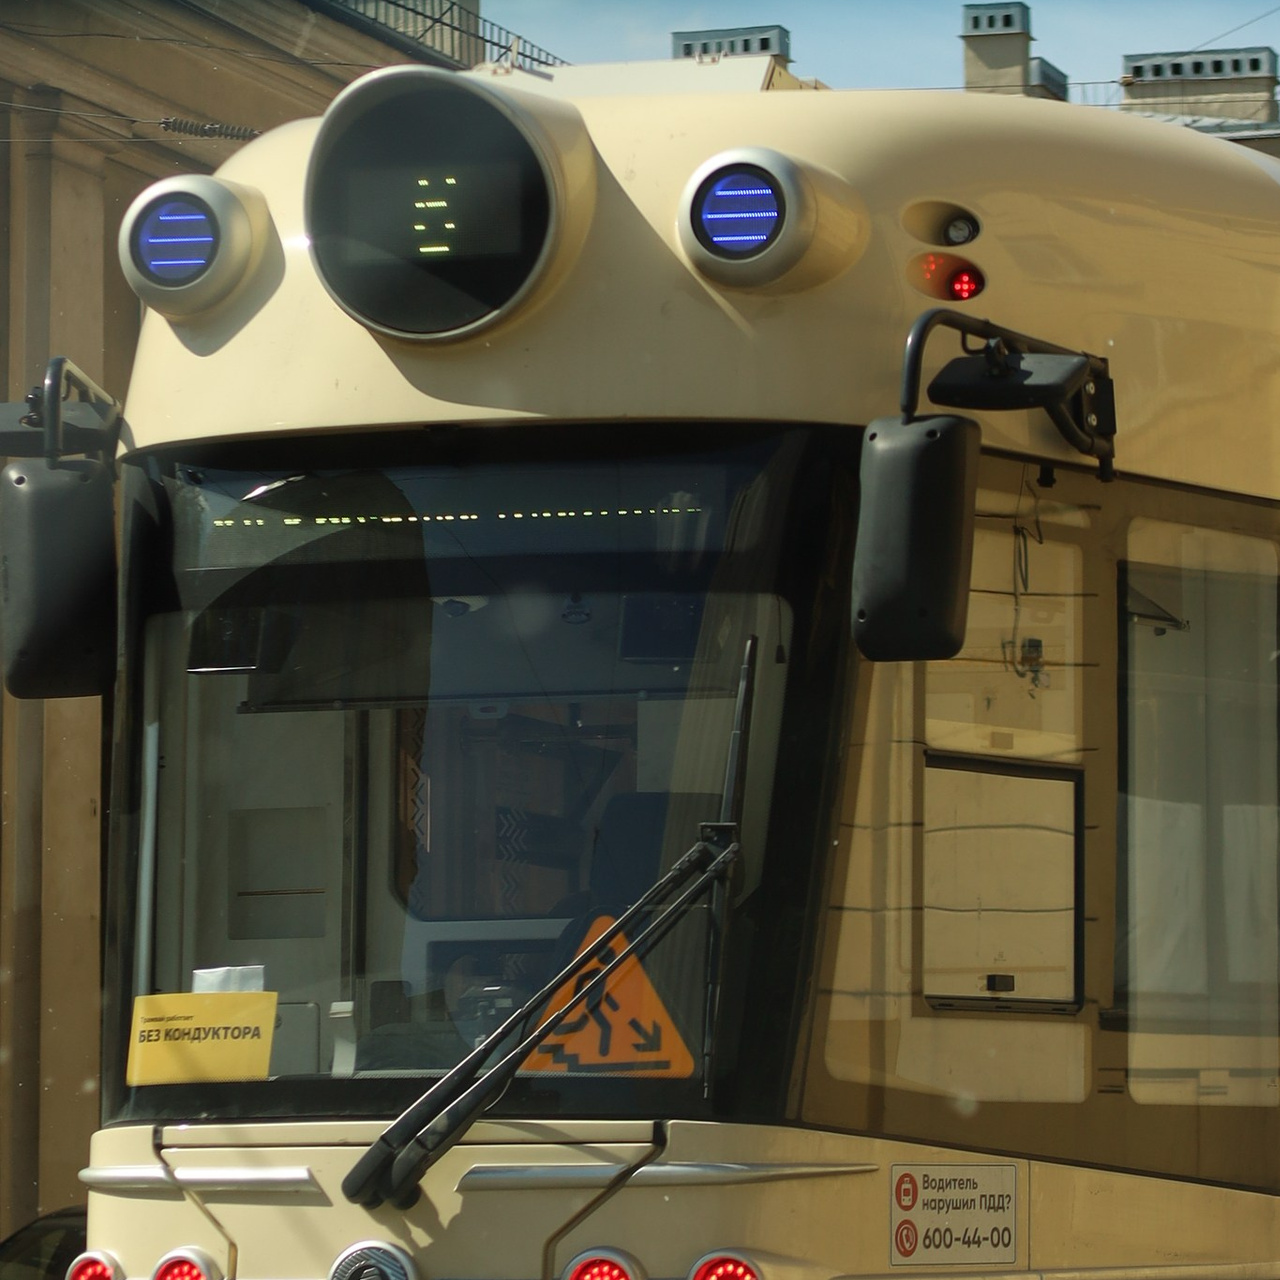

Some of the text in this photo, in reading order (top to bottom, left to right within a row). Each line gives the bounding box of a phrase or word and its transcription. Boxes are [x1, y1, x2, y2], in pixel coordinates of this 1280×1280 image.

[138, 1025, 262, 1043] БЕЗ КОНДУКТОРА
[922, 1174, 979, 1192] Водитель
[922, 1194, 1012, 1214] нарушил ПДД?
[922, 1226, 1012, 1249] 600-44-00
